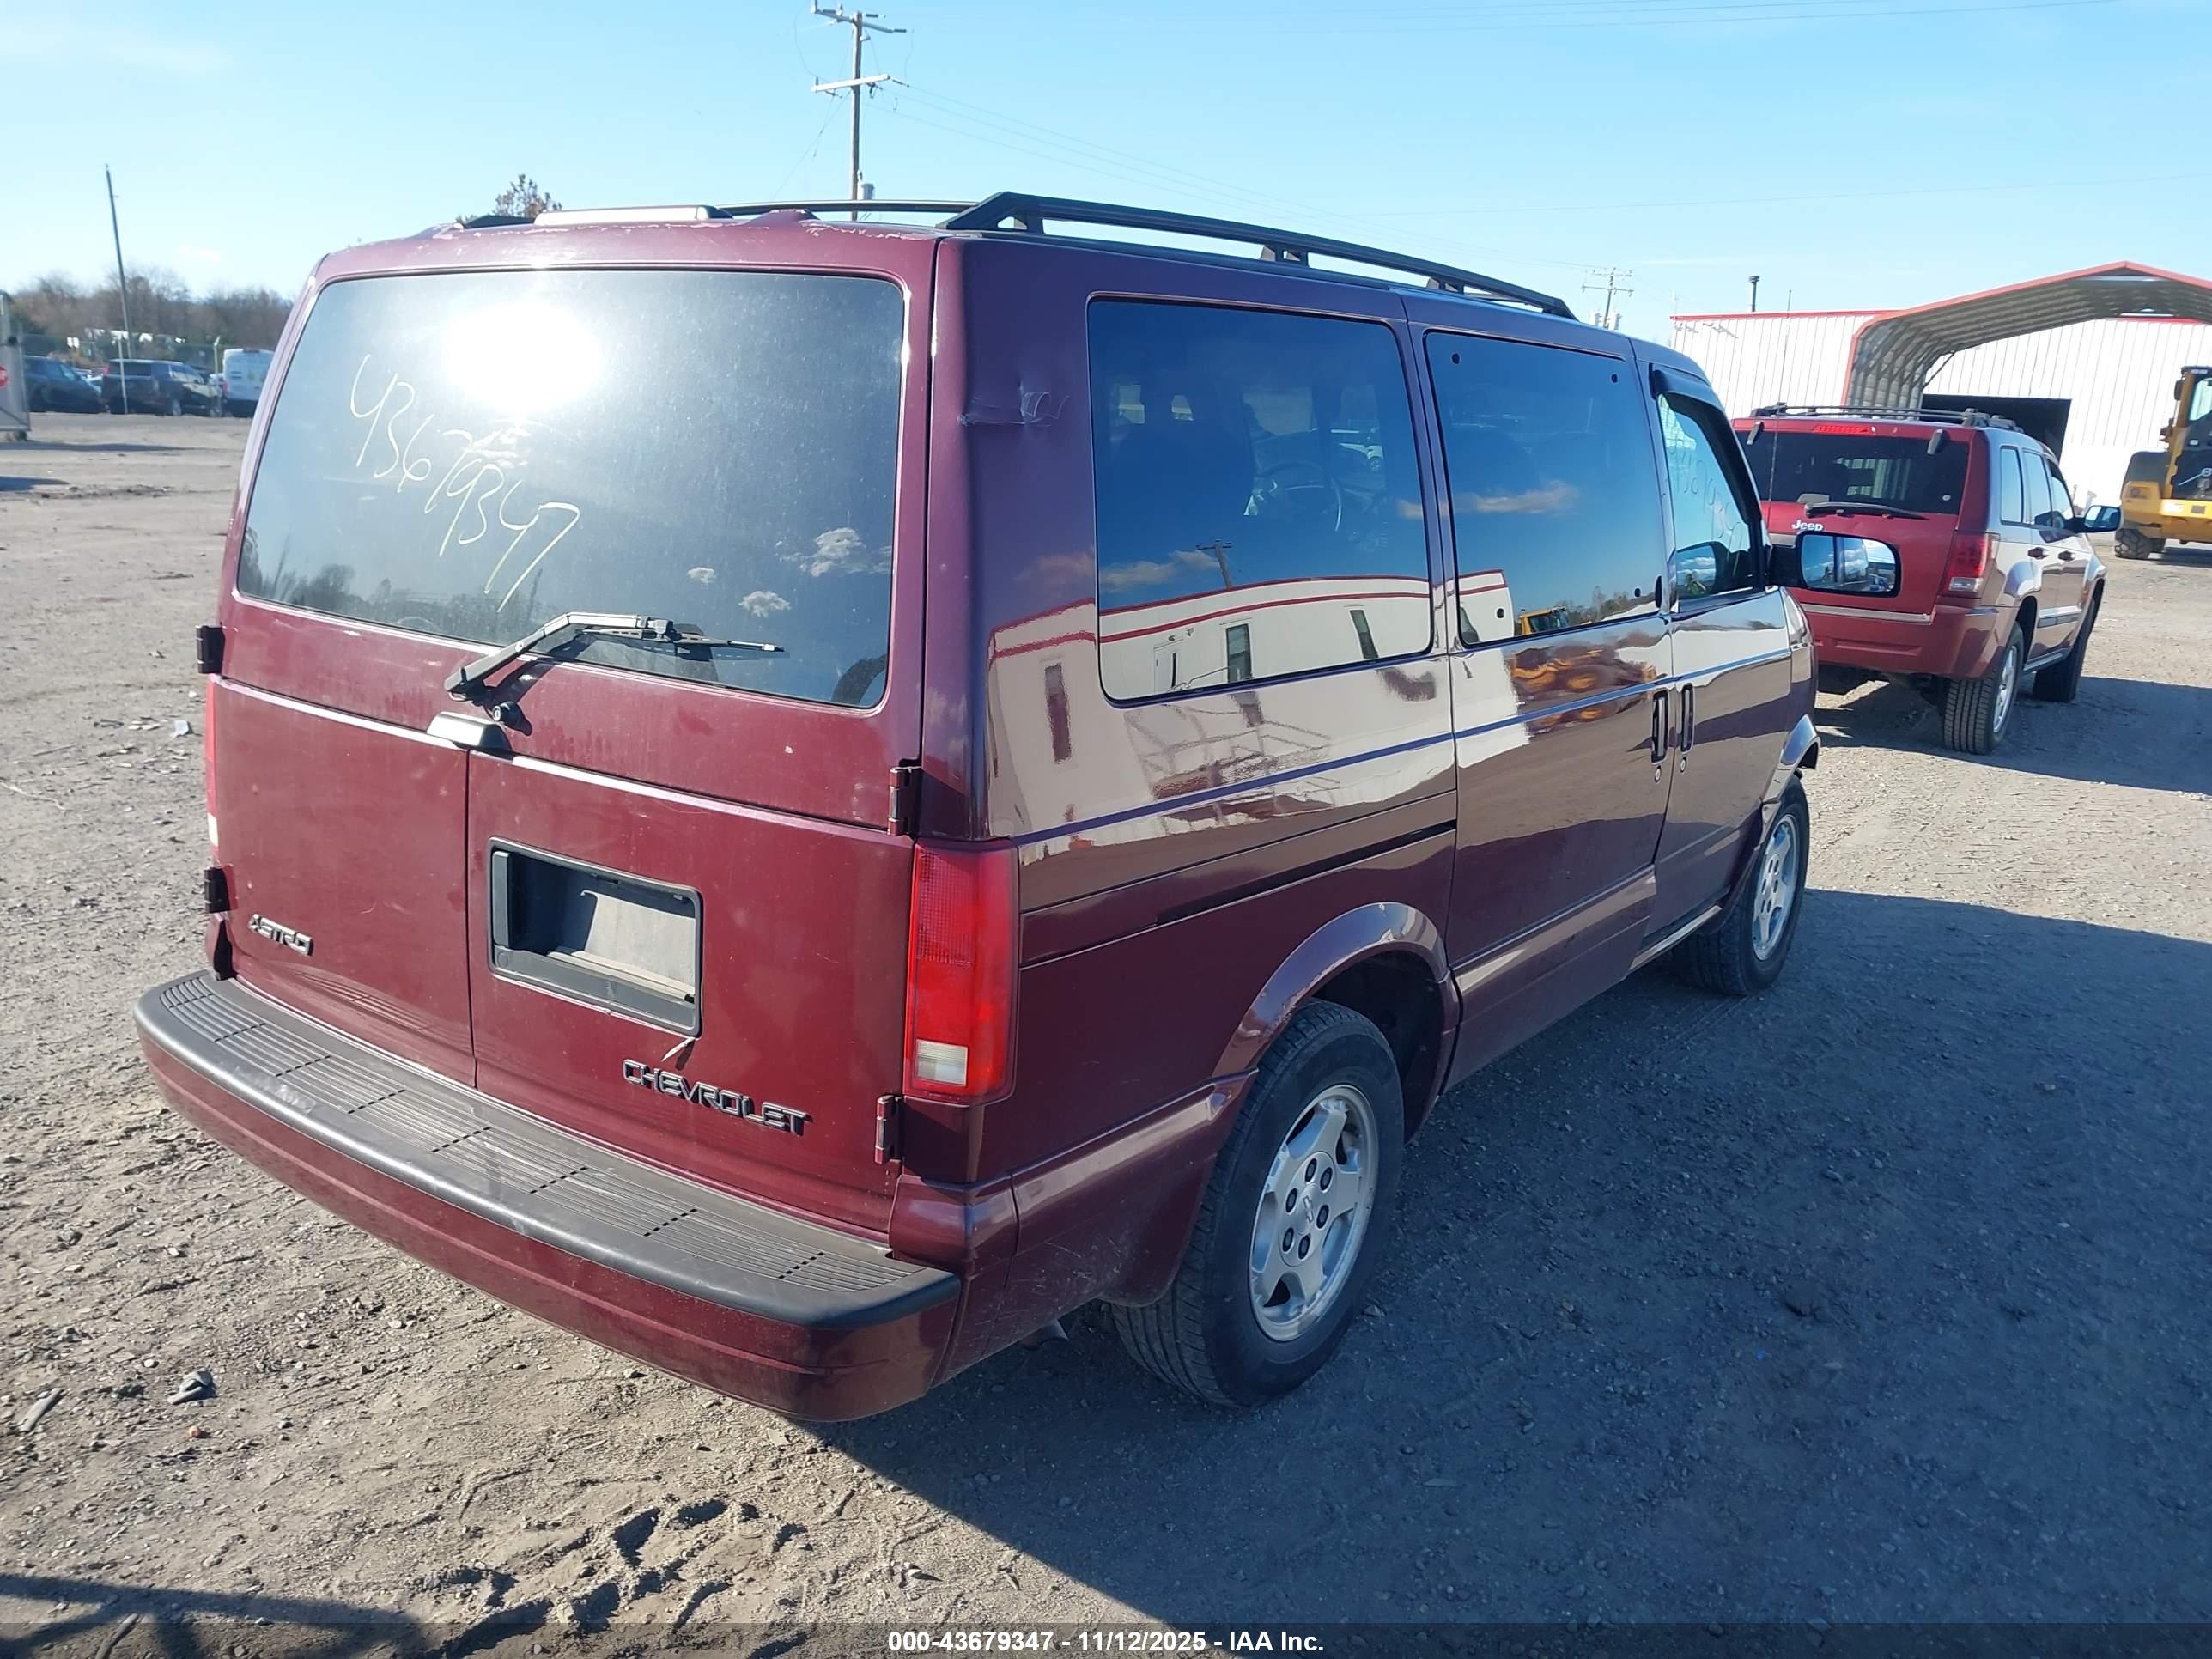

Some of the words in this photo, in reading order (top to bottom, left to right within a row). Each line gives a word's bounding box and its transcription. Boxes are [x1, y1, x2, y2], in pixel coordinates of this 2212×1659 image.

[349, 353, 580, 613] 43679347
[1791, 519, 1824, 532] Jeep
[248, 913, 313, 957] ASTRO
[623, 1058, 810, 1135] CHEVROLET
